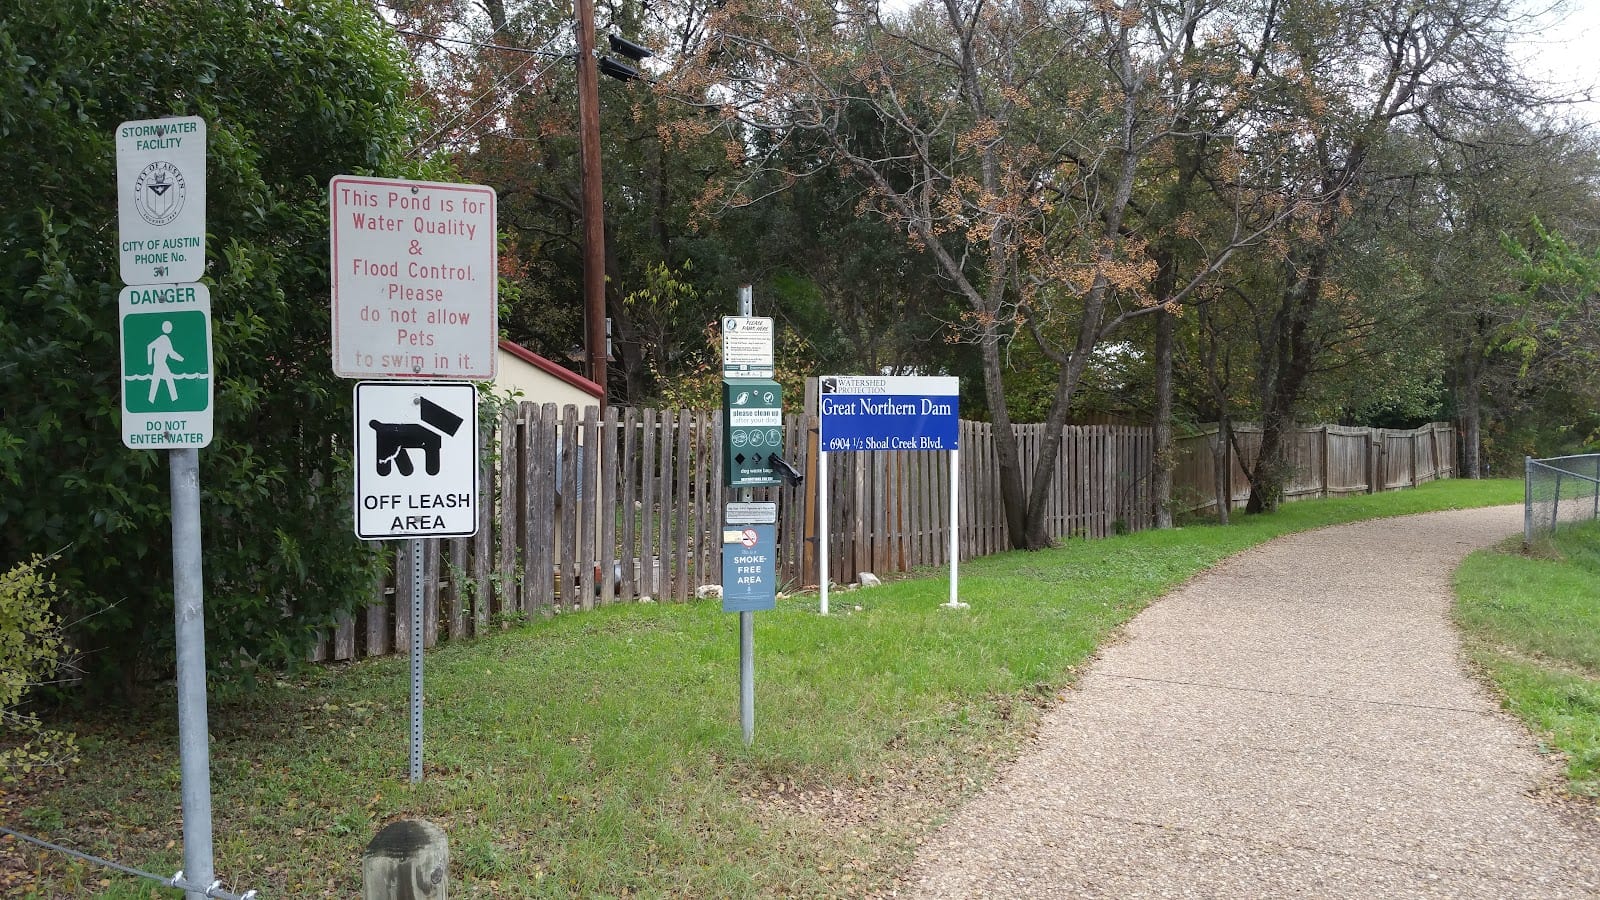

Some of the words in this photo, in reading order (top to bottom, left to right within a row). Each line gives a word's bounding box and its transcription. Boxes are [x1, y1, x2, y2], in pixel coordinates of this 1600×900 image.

[122, 122, 197, 138] STORMWATER
[137, 138, 182, 150] FACILITY
[136, 172, 147, 192] CITY
[149, 163, 158, 171] OF
[163, 163, 185, 189] AUSTIN
[341, 188, 378, 207] This
[388, 192, 430, 211] Pond
[440, 199, 454, 213] is
[463, 197, 485, 214] for
[352, 213, 404, 232] Water
[414, 216, 476, 241] Quality
[122, 240, 145, 252] CITY
[149, 239, 160, 250] OF
[163, 236, 200, 249] AUSTIN
[408, 239, 423, 256] &
[135, 252, 168, 264] PHONE
[171, 252, 187, 263] No.
[153, 266, 169, 278] 31
[353, 259, 398, 277] Flood
[408, 262, 475, 281] Control.
[130, 287, 196, 305] DANGER
[388, 283, 443, 301] Please
[360, 305, 380, 322] do
[390, 308, 417, 323] not
[427, 309, 470, 325] allow
[397, 329, 434, 346] Pets
[355, 352, 373, 367] to
[381, 352, 424, 369] swim
[434, 353, 449, 369] in
[458, 353, 474, 370] it.
[838, 379, 886, 387] WATERSHED
[838, 386, 886, 394] PROTECTION
[822, 398, 856, 416] Great
[860, 398, 916, 416] Northern
[921, 398, 952, 416] Dam
[146, 421, 162, 431] DO
[164, 420, 187, 431] NOT
[130, 433, 164, 444] ENTER
[167, 433, 203, 443] WATER
[830, 437, 851, 450] 6904
[865, 436, 889, 449] Shoal
[891, 436, 918, 449] Creek
[920, 436, 943, 449] Blvd.
[364, 495, 402, 510] OFF
[408, 493, 470, 509] LEASH
[390, 515, 446, 531] AREA
[733, 555, 767, 564] SMOKE-
[738, 565, 761, 574] FREE
[737, 576, 762, 585] AREA
